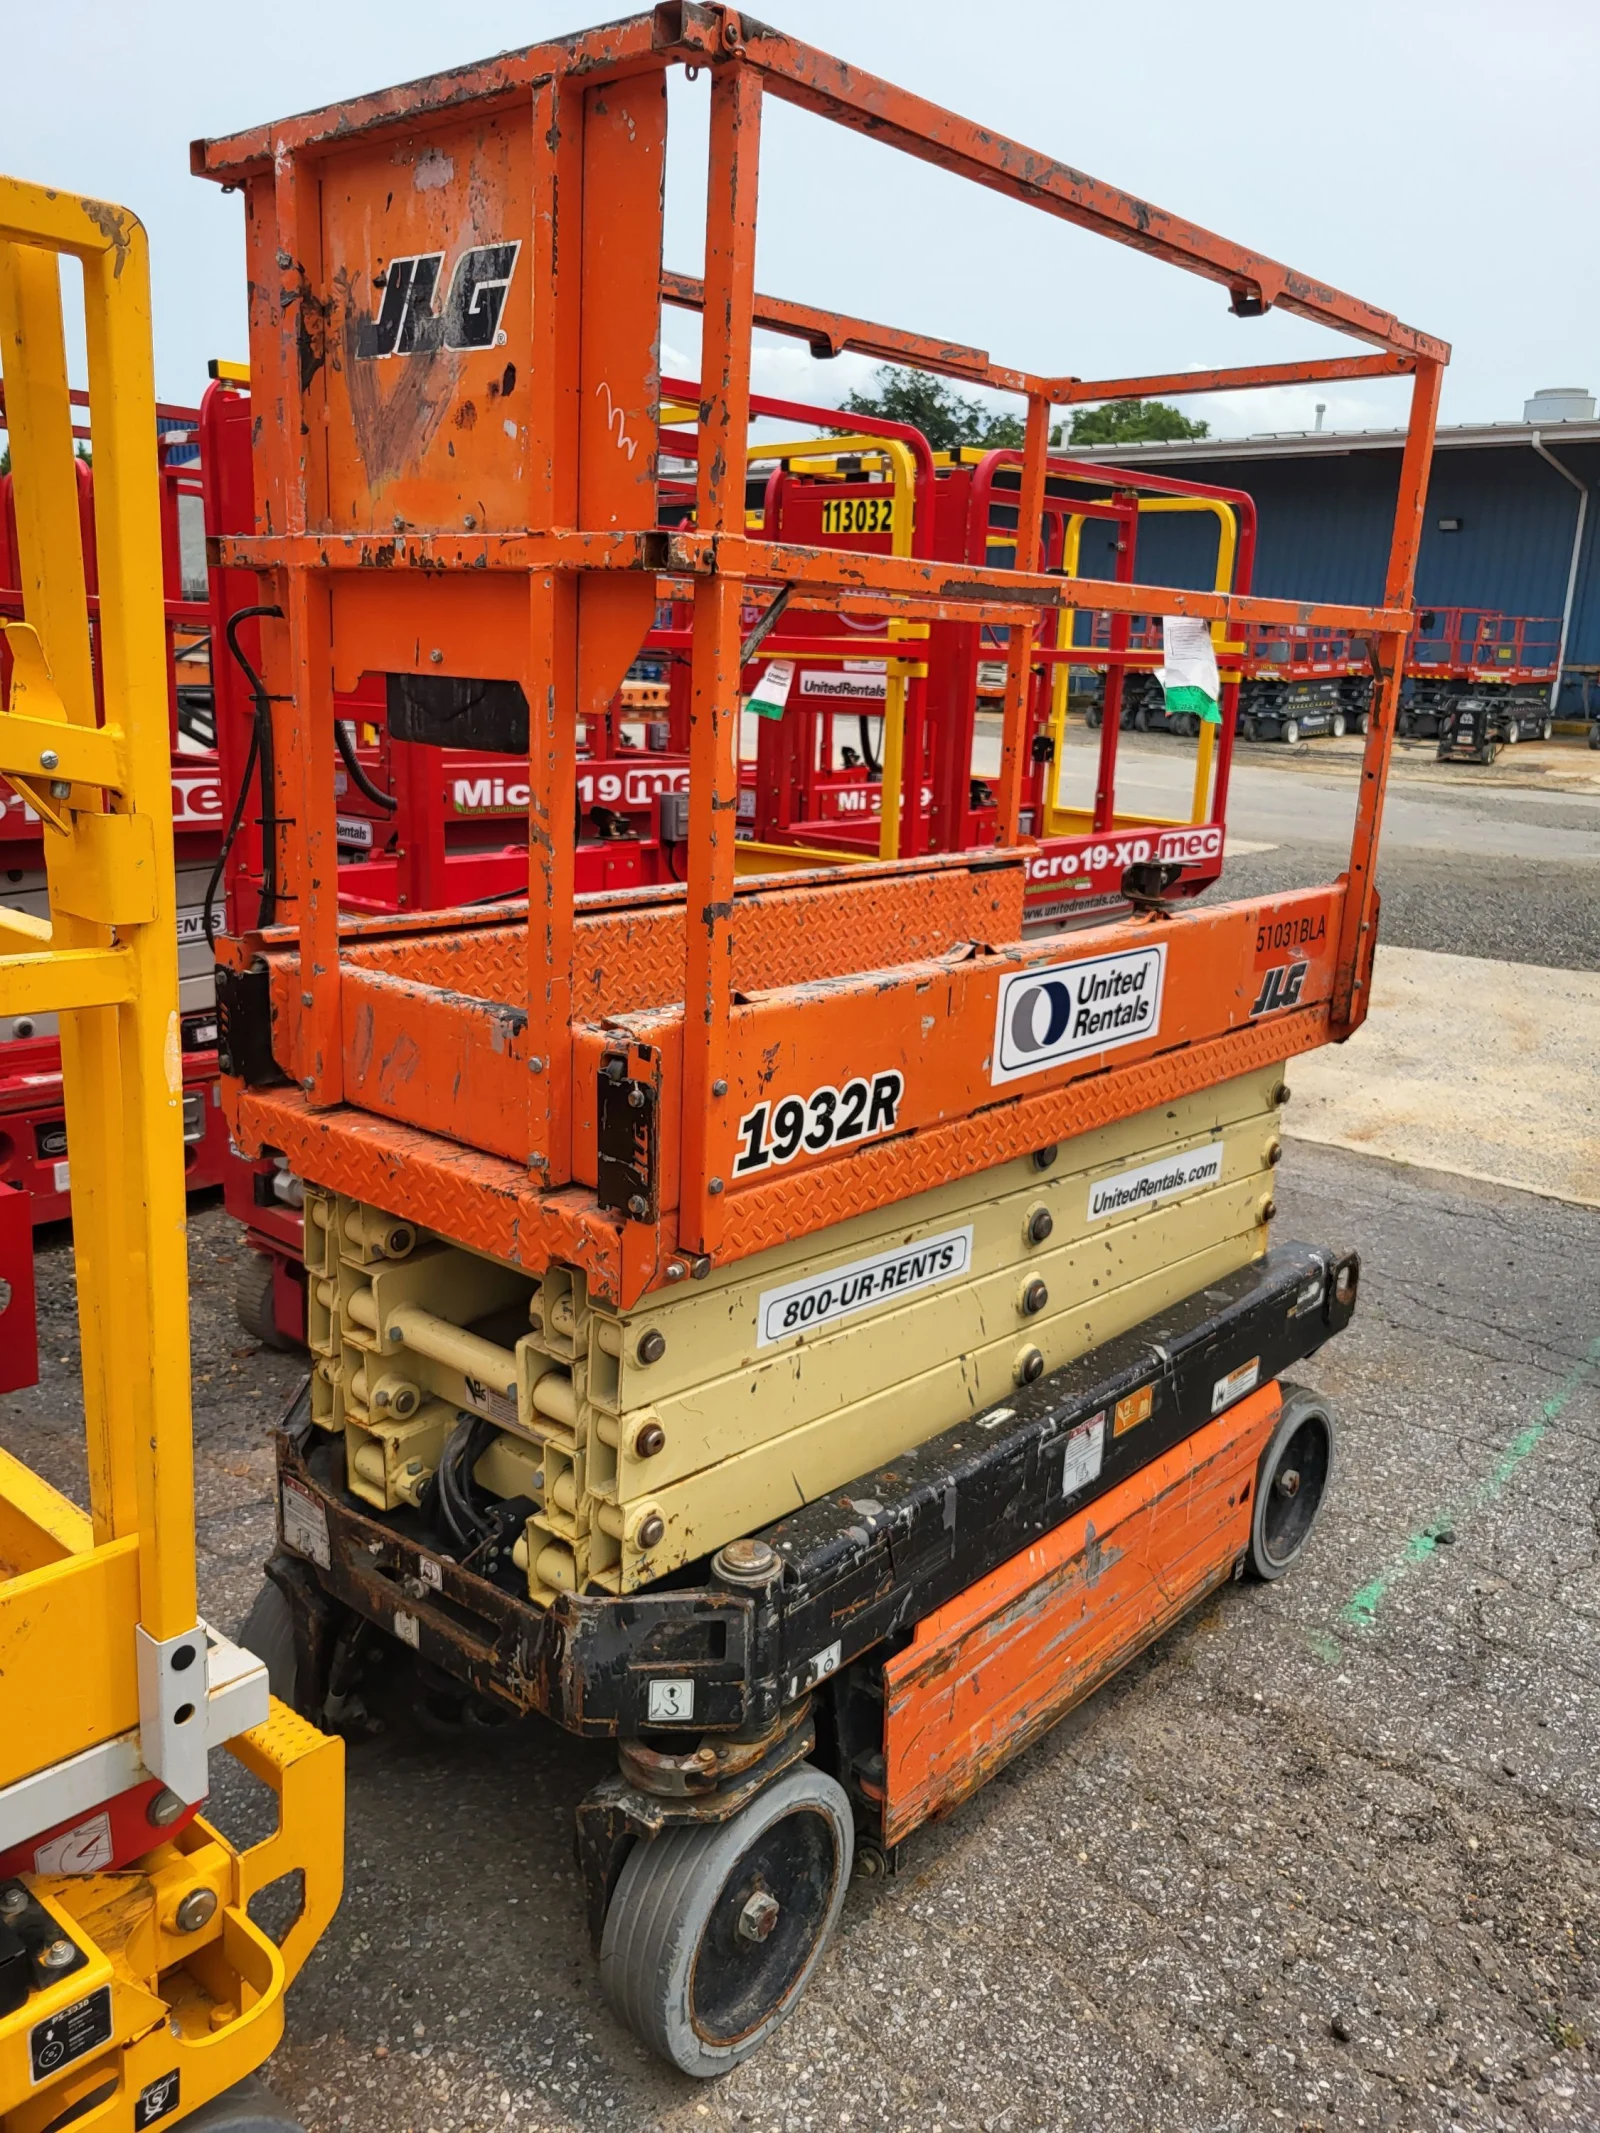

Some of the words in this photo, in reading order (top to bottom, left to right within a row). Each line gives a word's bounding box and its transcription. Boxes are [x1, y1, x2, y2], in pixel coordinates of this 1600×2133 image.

[824, 500, 893, 533] 113032
[1159, 833, 1221, 860] mec
[1256, 914, 1326, 952] 51031BLA
[1077, 966, 1147, 1005] United
[1250, 962, 1307, 1018] JLG
[1072, 996, 1149, 1040] Rentals
[736, 1073, 902, 1173] 1932R
[1092, 1158, 1218, 1215] UnitedRentals.com
[782, 1244, 954, 1328] 800-UR-RENTS
